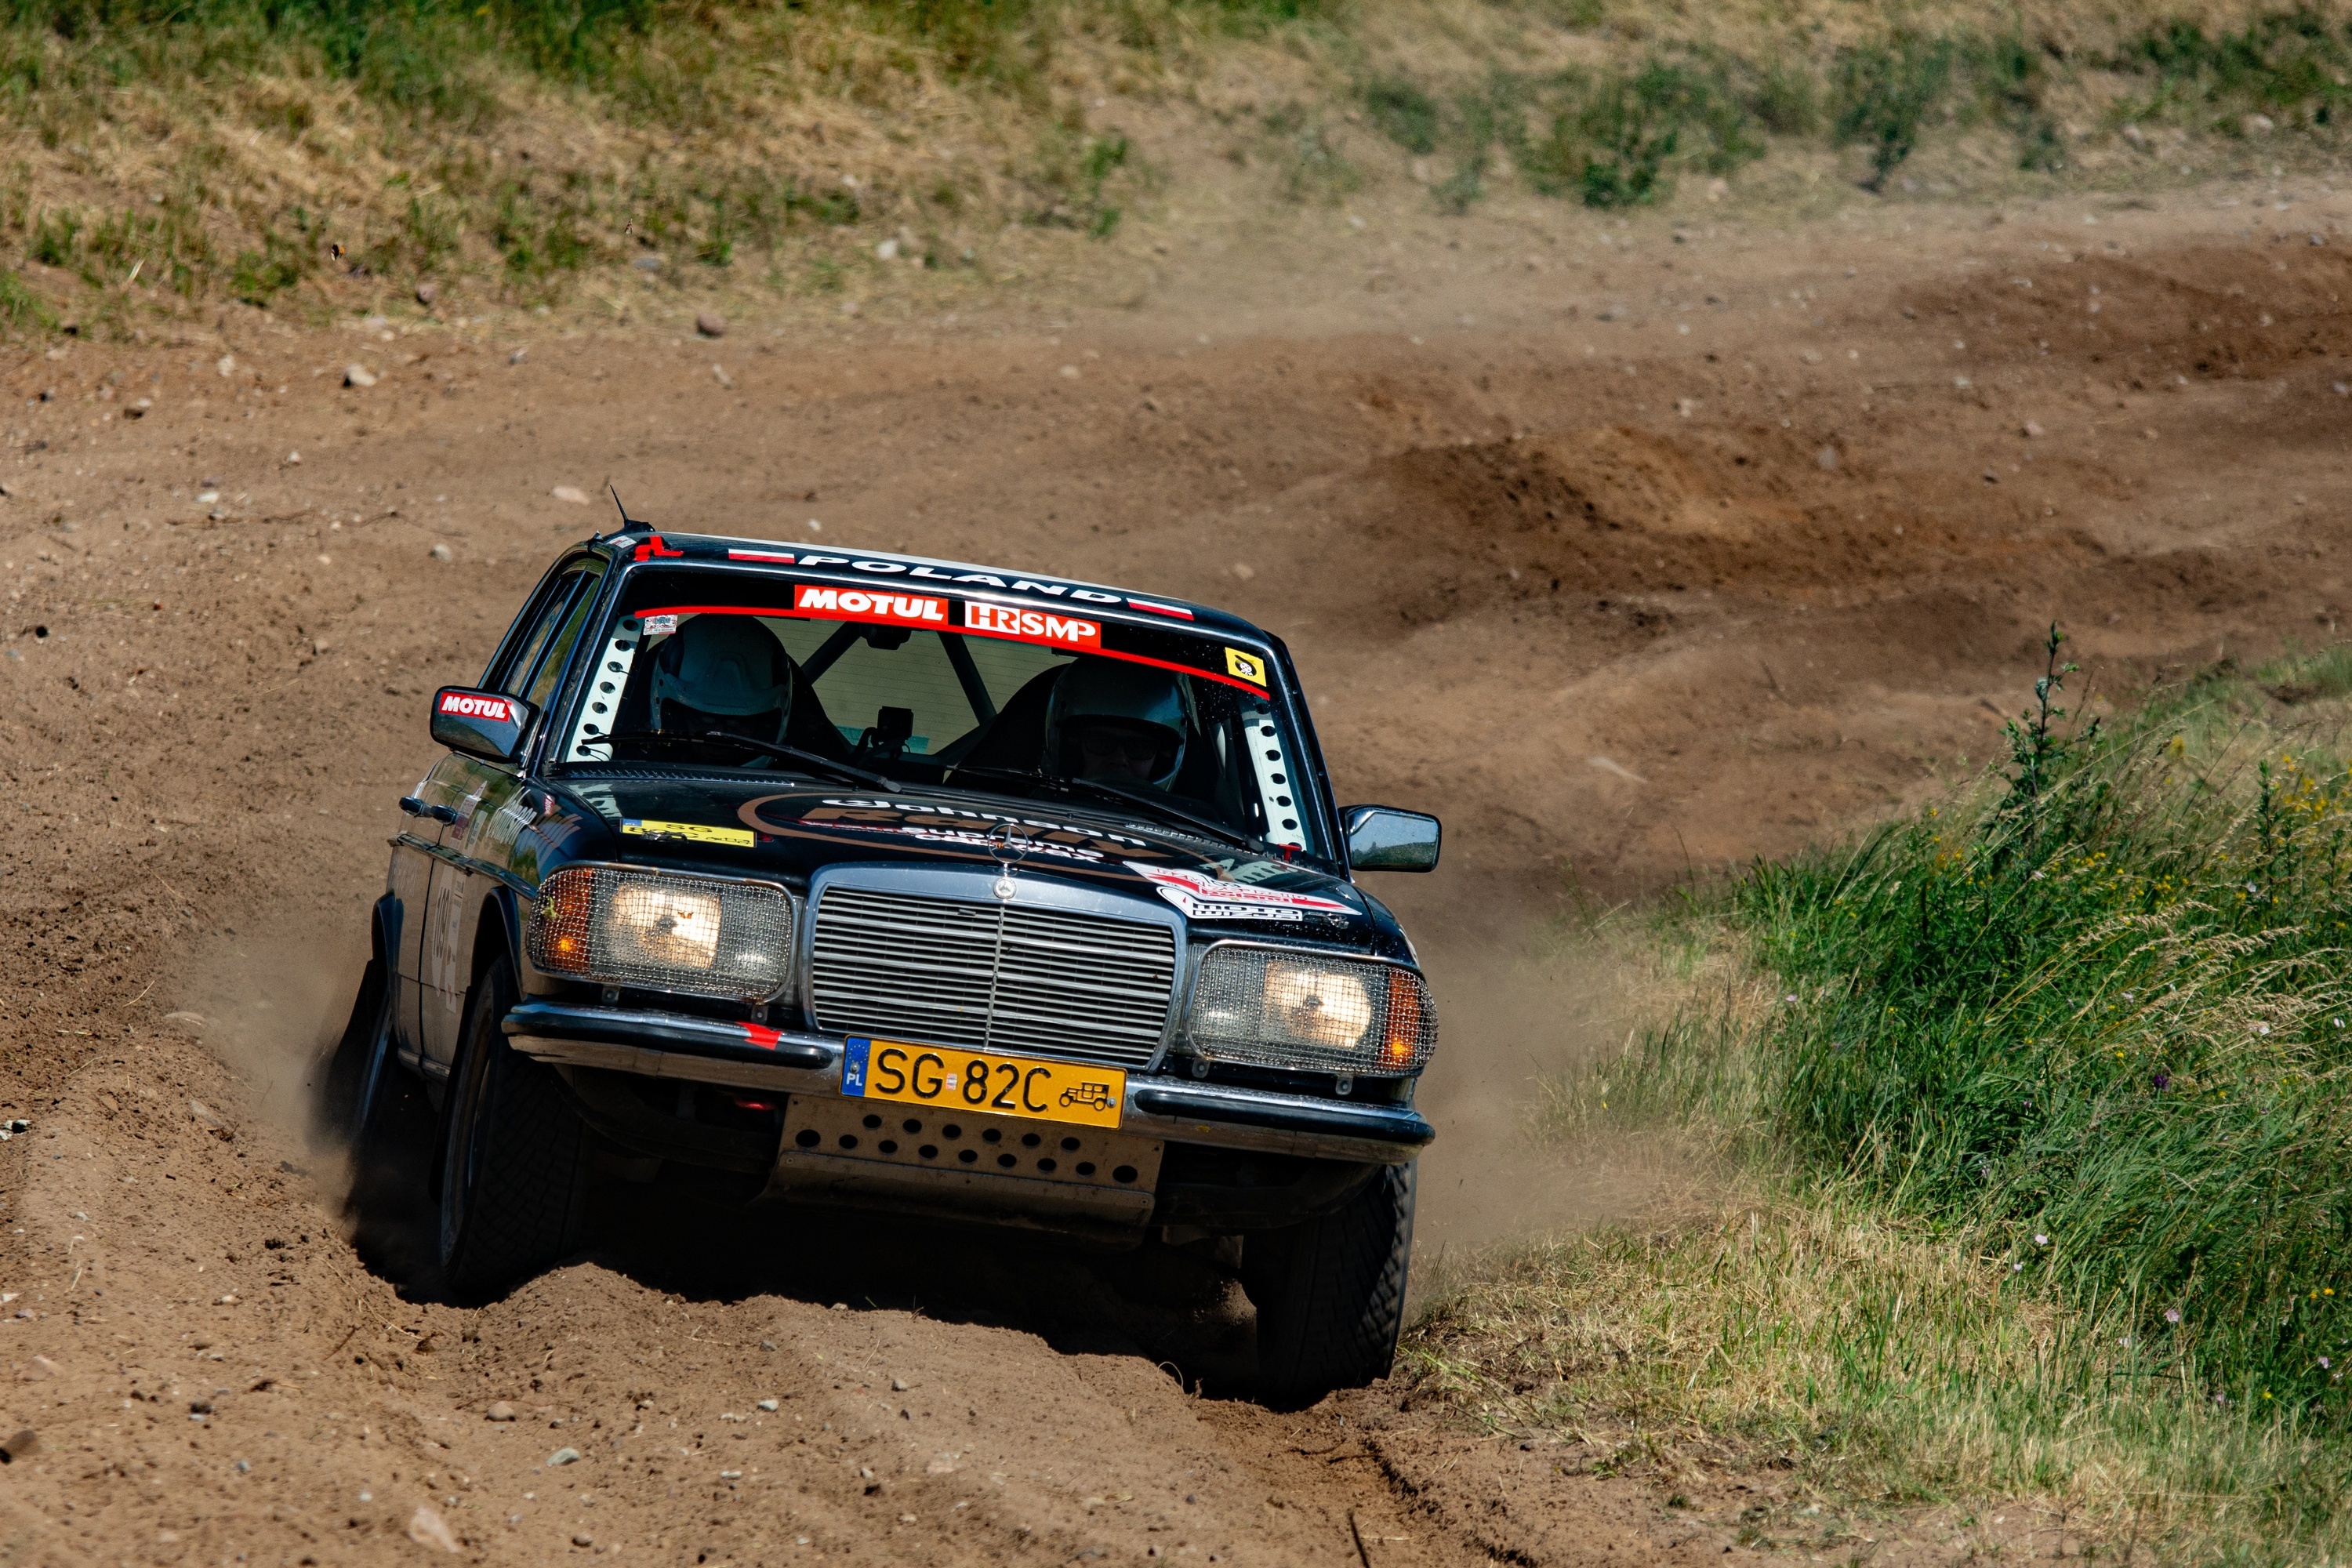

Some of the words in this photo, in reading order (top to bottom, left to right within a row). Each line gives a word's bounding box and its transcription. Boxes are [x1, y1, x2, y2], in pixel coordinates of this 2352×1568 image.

[797, 554, 1124, 604] POLAND
[797, 588, 946, 622] MOTUL
[967, 602, 1096, 644] HRSMP
[441, 695, 507, 720] MOTUL
[629, 827, 699, 838] 8C
[666, 823, 712, 833] SG
[801, 807, 1174, 858] Rally
[822, 799, 1147, 847] Johnson
[846, 1073, 862, 1087] PL
[875, 1048, 945, 1099] SG
[963, 1059, 1052, 1112] 82C
